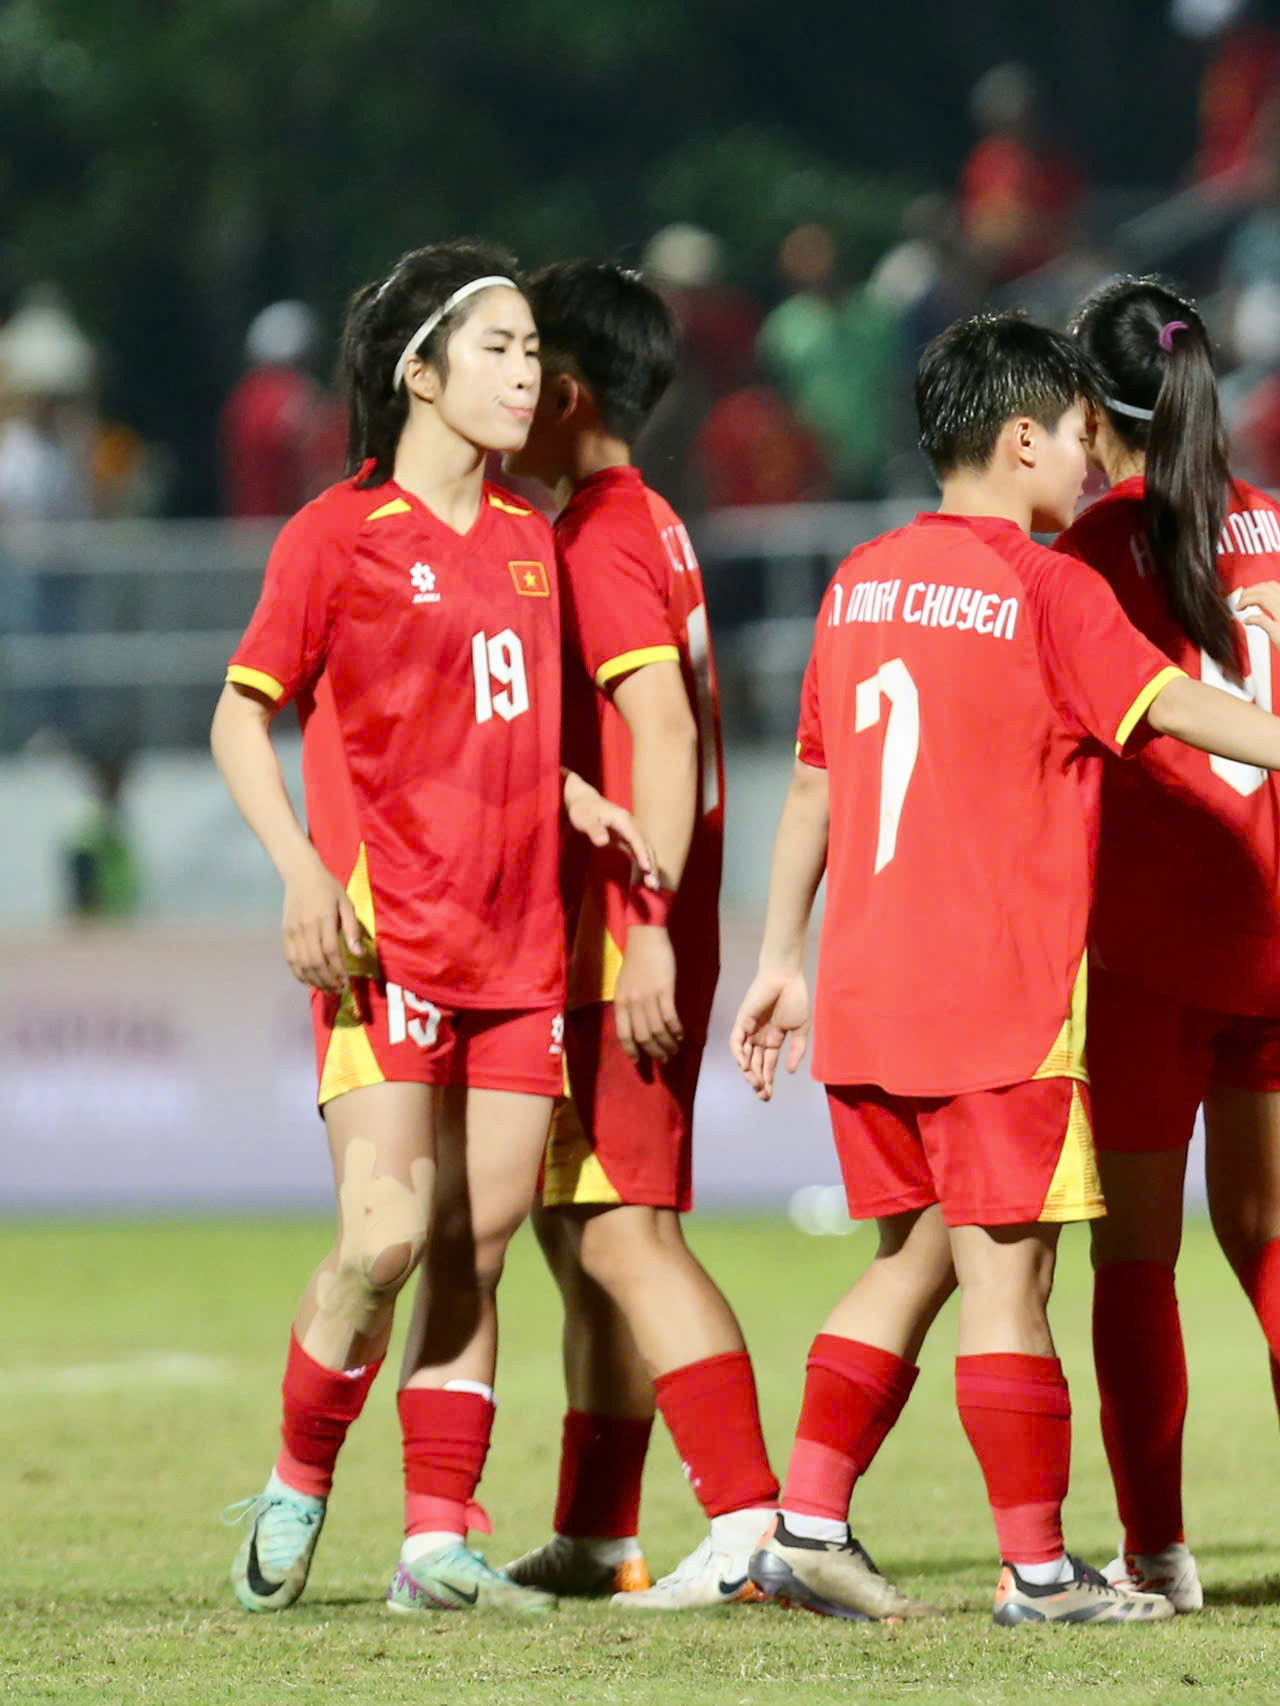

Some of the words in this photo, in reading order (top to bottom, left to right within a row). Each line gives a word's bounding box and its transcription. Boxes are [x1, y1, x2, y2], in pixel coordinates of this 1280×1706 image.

[902, 581, 1019, 641] CHUYEN
[472, 627, 530, 725] 19
[855, 656, 921, 876] 7
